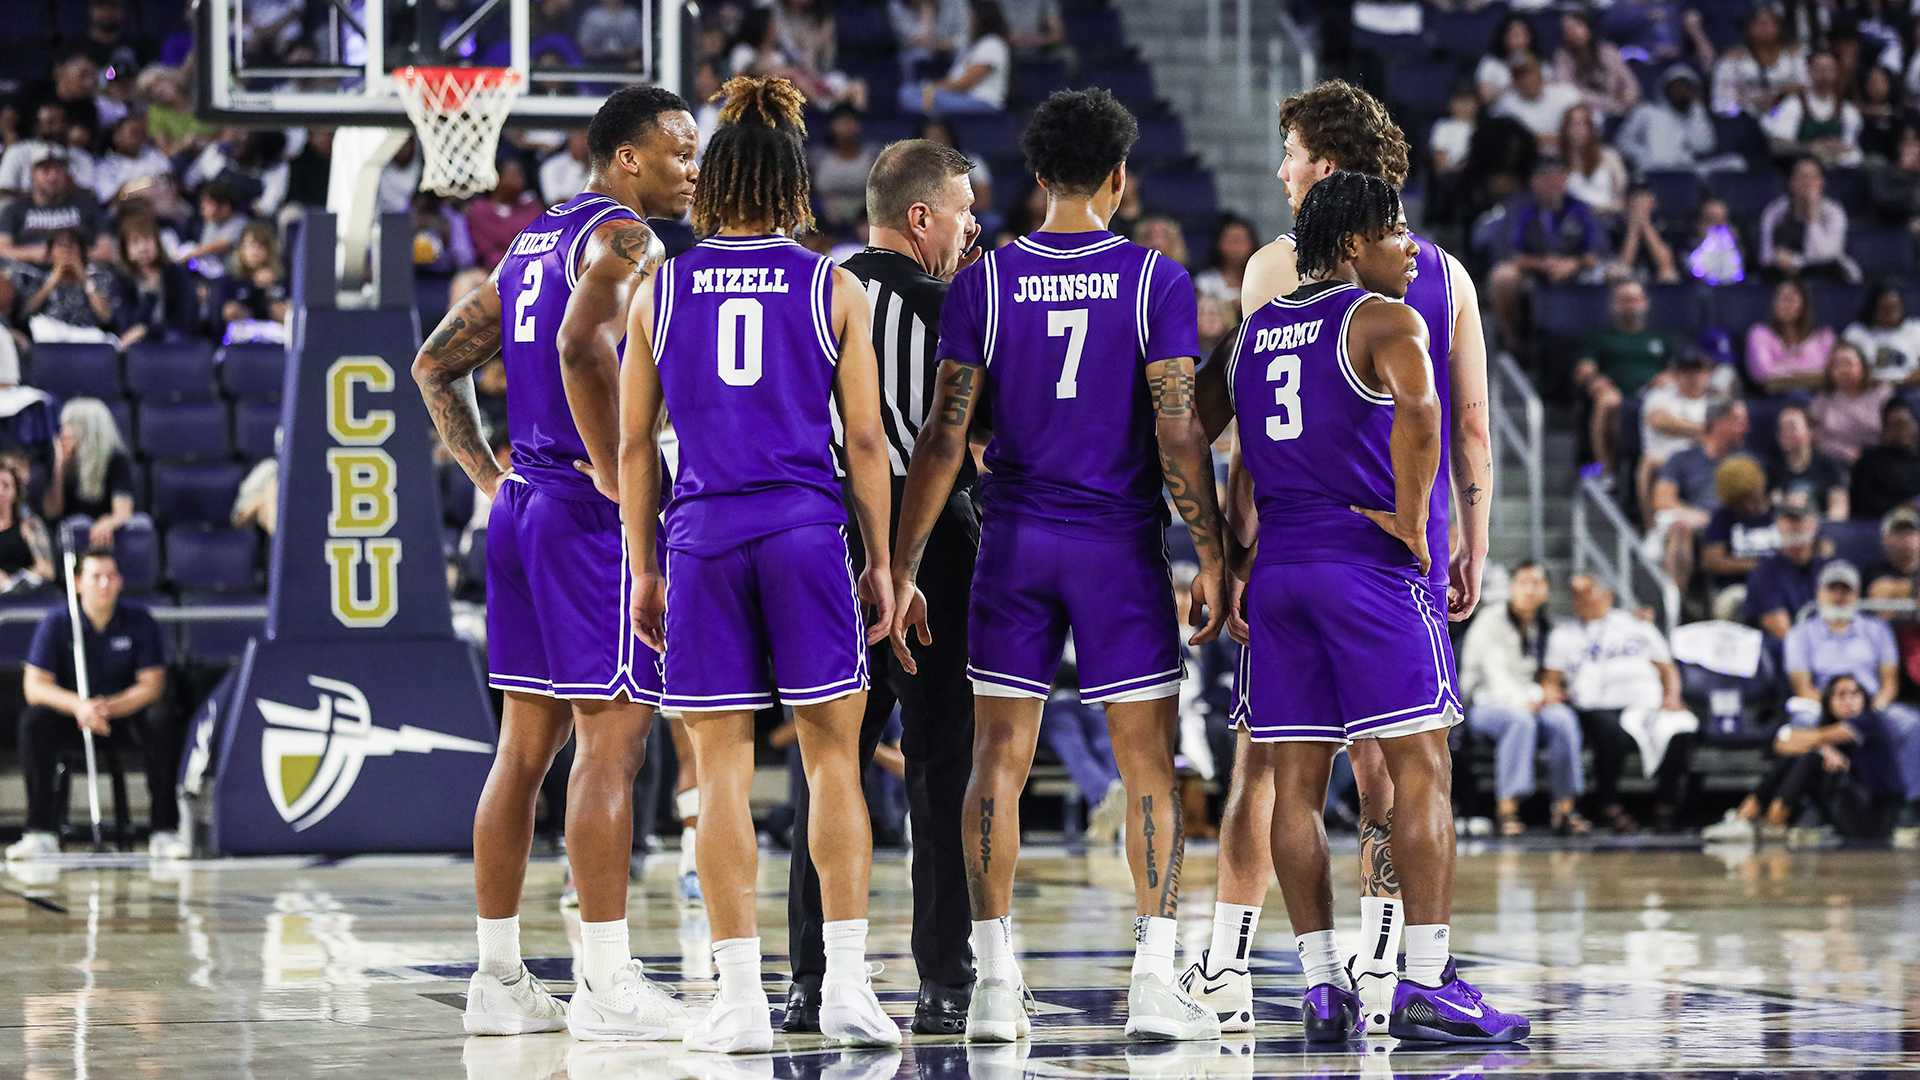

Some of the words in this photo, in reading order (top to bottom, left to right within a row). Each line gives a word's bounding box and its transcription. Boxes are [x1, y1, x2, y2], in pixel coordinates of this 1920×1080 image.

[513, 228, 564, 255] HICKS
[692, 267, 790, 294] MIZELL
[514, 259, 543, 342] 2
[1013, 273, 1120, 303] JOHNSON
[717, 297, 763, 386] 0
[1047, 308, 1089, 399] 7
[1253, 318, 1324, 354] DORMU
[940, 366, 974, 426] 45
[1265, 354, 1303, 441] 3
[325, 355, 402, 628] CBU
[980, 797, 995, 874] MOST
[1142, 795, 1159, 889] HATED
